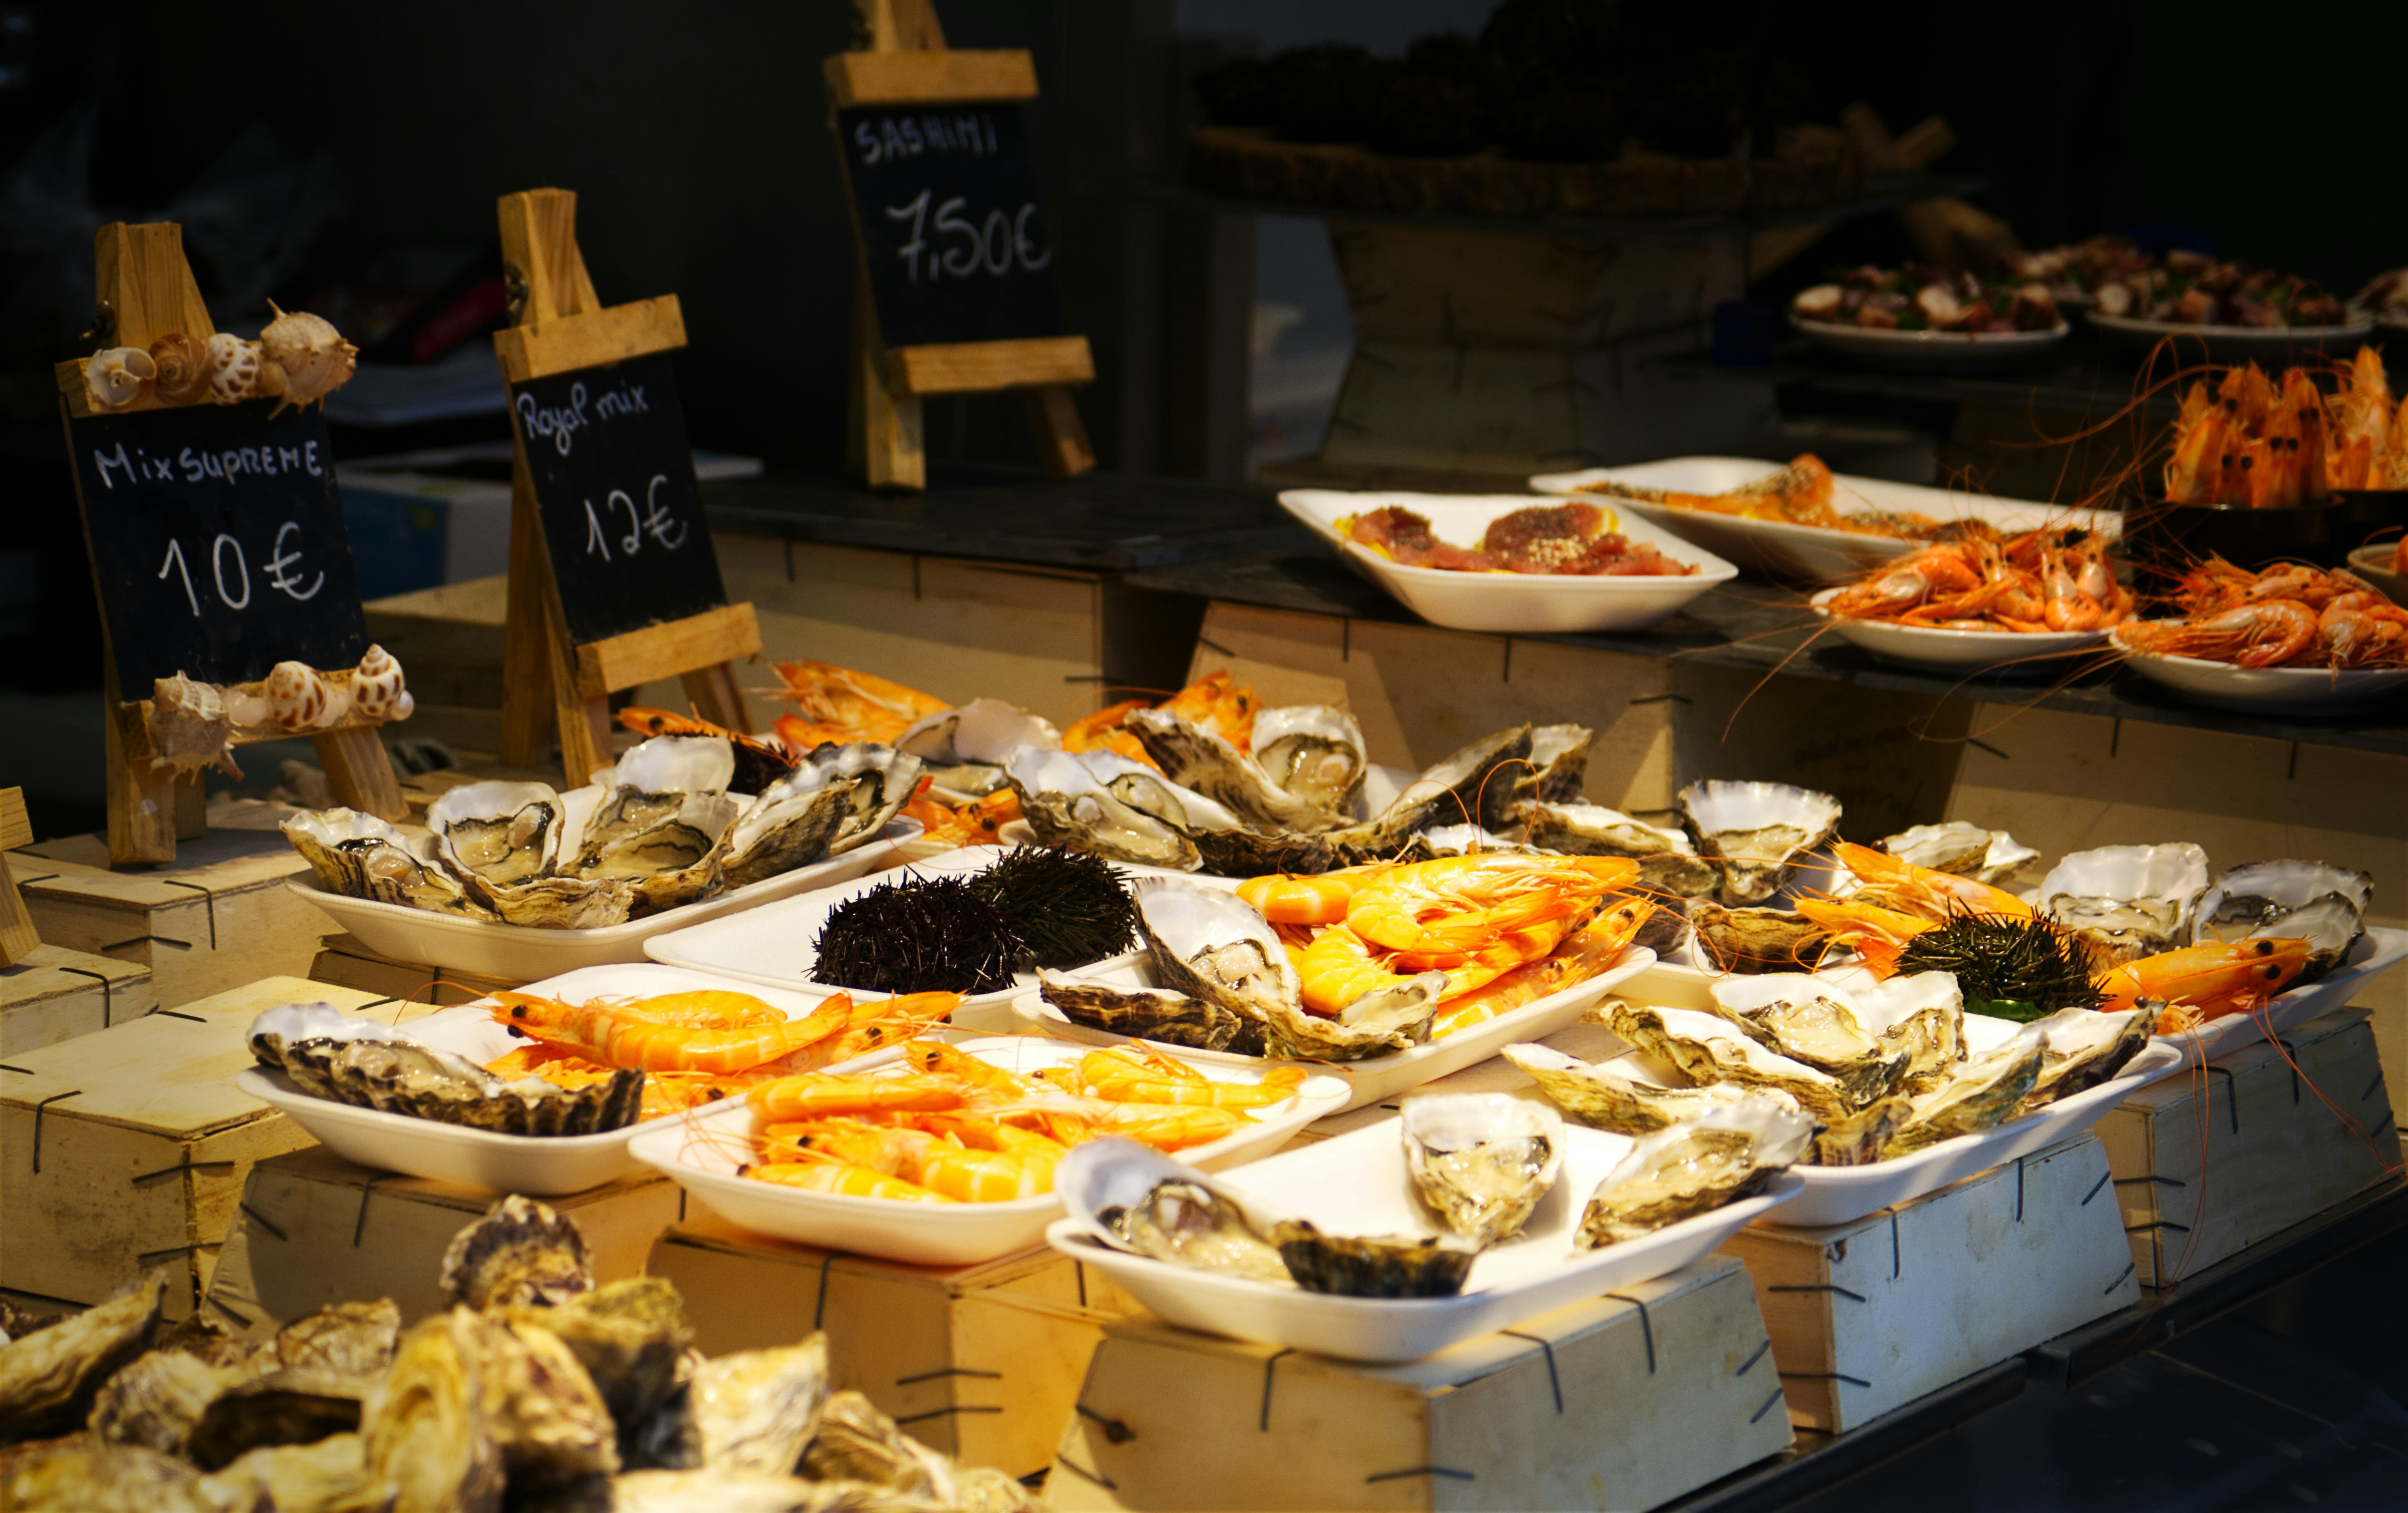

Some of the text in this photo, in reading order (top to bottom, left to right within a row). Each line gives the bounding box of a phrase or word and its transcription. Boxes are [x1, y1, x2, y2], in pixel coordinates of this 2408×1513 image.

[517, 380, 649, 456] Royal mix
[583, 473, 688, 562] 12€
